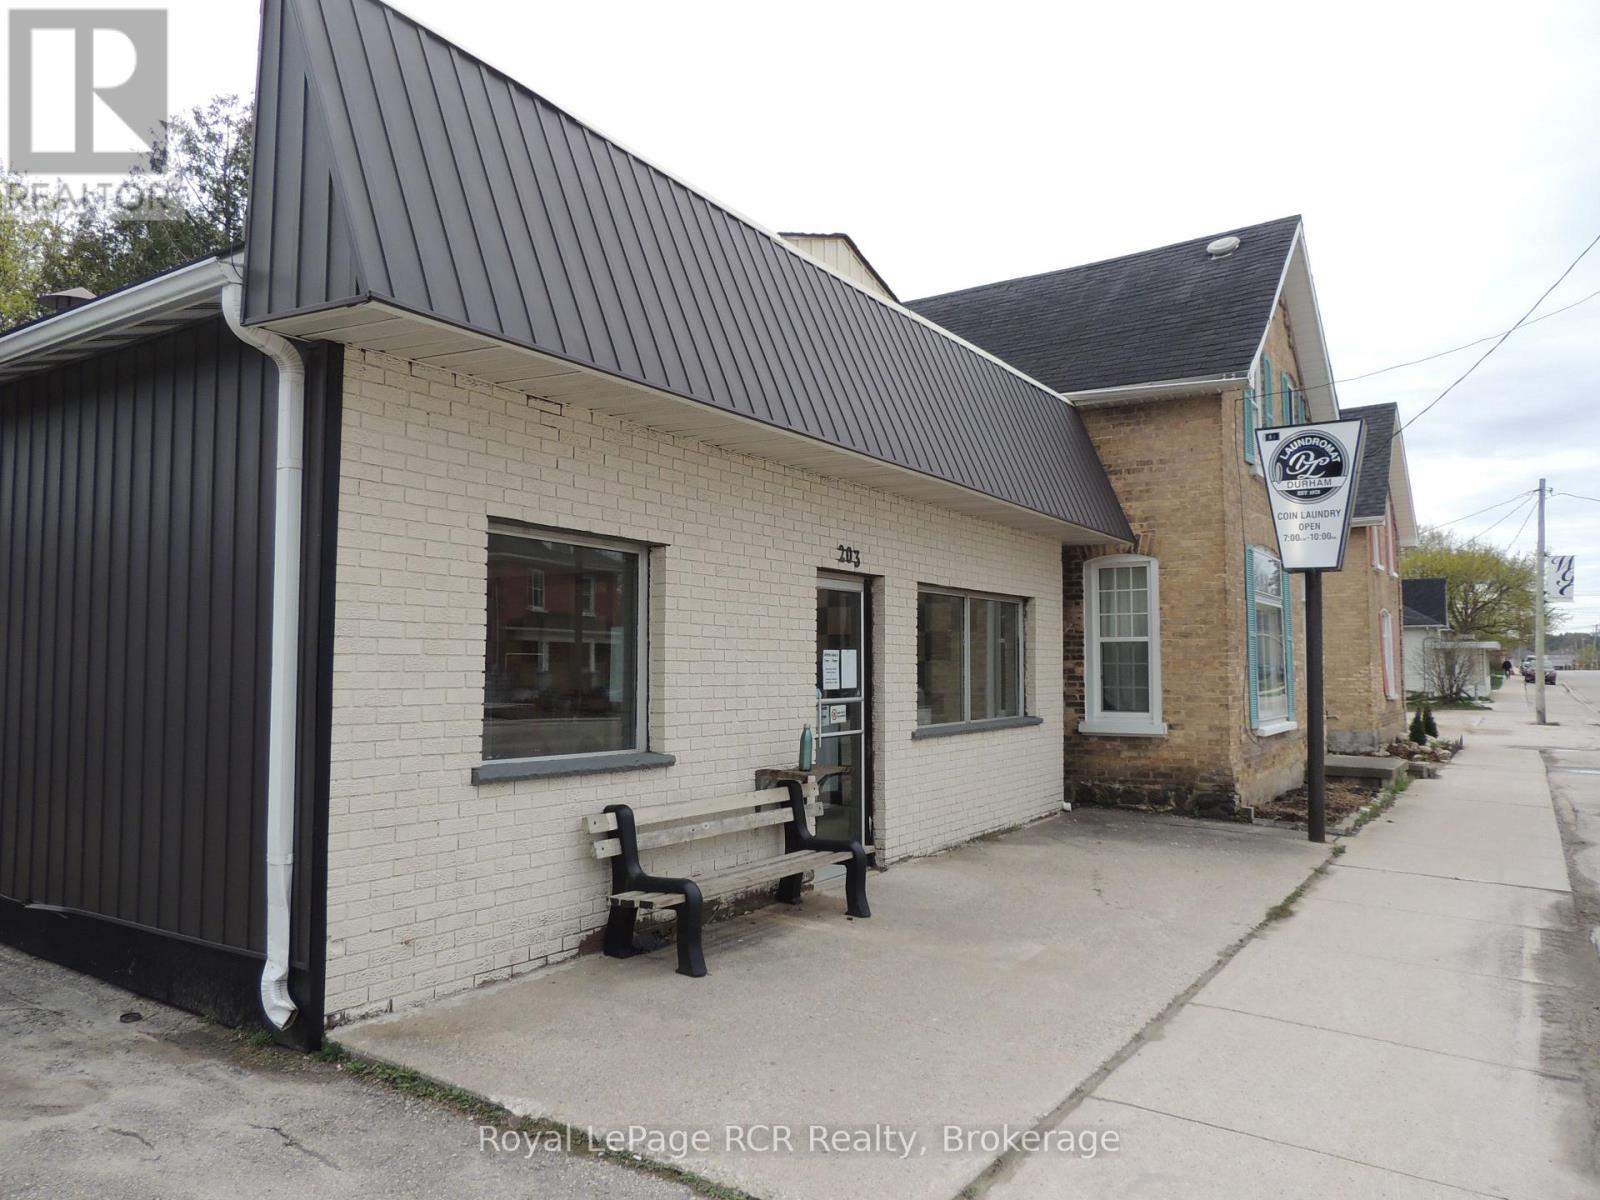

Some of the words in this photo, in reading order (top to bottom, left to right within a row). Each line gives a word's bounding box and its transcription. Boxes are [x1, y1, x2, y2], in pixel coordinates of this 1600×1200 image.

[1280, 437, 1340, 462] LAUNDROMAT
[1287, 479, 1332, 489] DURHAM
[1277, 512, 1298, 521] COIN
[1300, 509, 1341, 520] LAUNDRY
[1298, 522, 1321, 531] OPEN
[835, 544, 860, 568] 203
